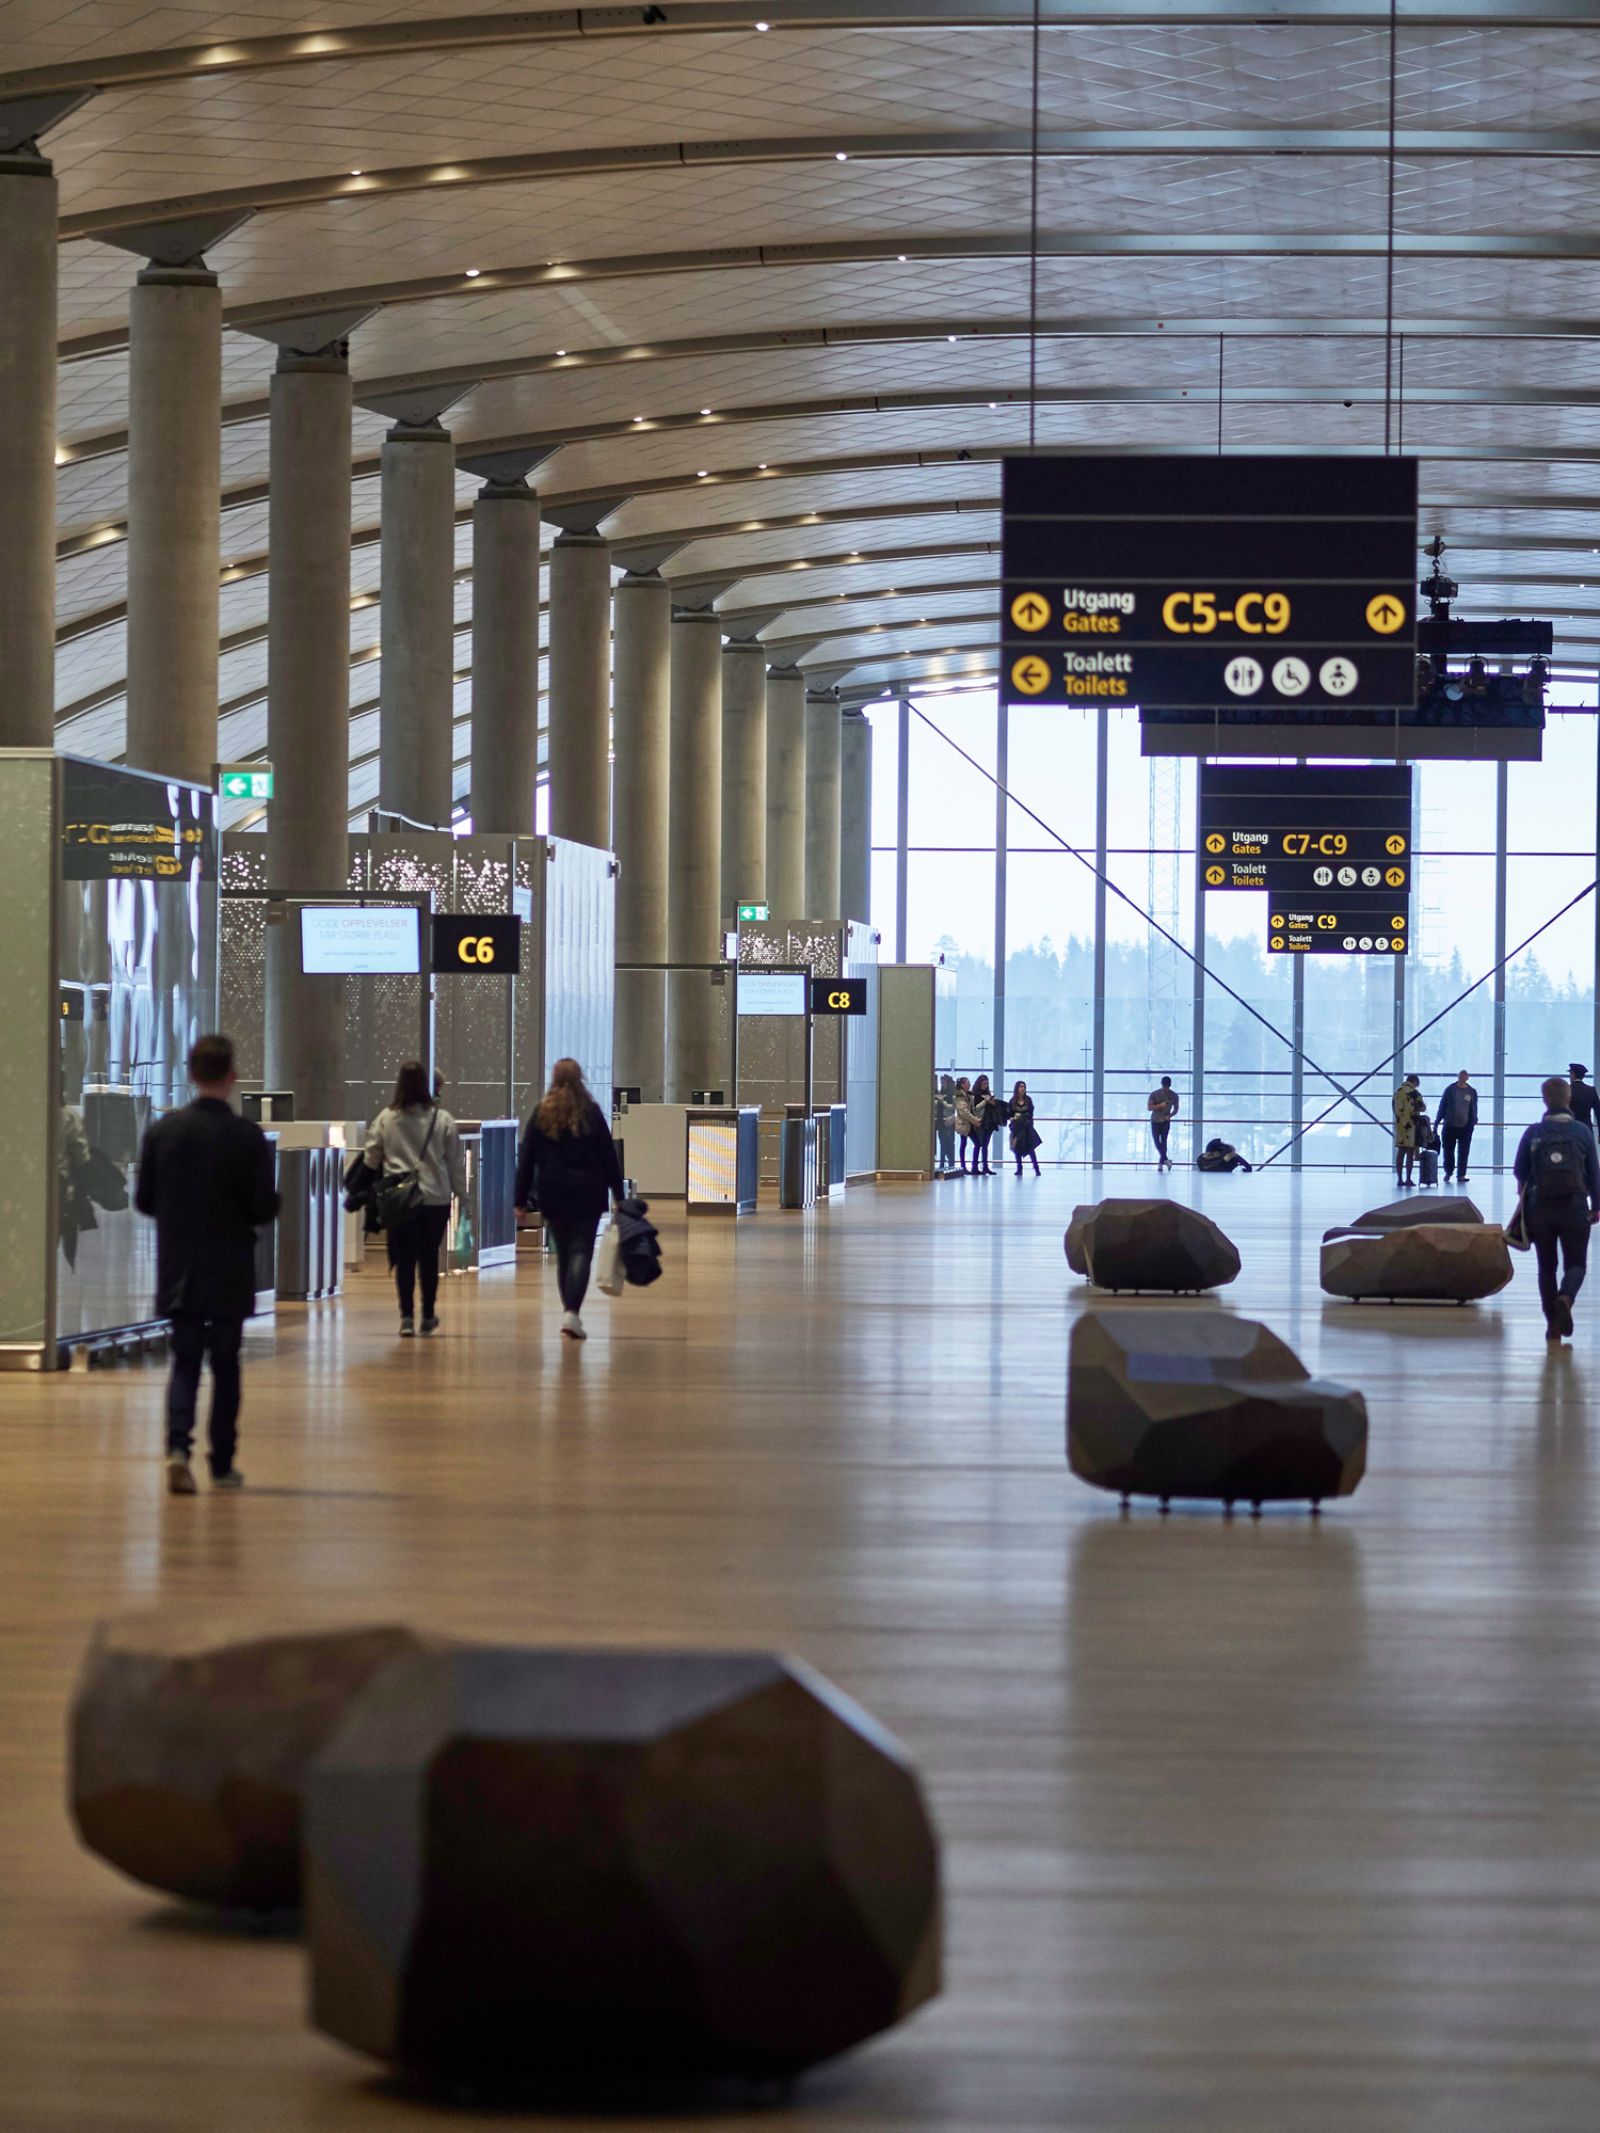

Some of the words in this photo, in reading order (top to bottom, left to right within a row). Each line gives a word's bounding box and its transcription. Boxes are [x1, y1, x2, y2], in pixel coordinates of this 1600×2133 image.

[1063, 588, 1135, 614] Utgang
[1162, 592, 1291, 634] C5-C9
[1063, 611, 1120, 633] Gates
[1063, 651, 1133, 673] Toalett
[1063, 674, 1127, 696] Toilets
[1232, 832, 1268, 844] Utgang
[1282, 834, 1348, 855] C7-C9
[1232, 844, 1261, 854] Gates
[1232, 863, 1267, 874] Toalett
[1232, 876, 1264, 886] Toilets
[1288, 914, 1313, 922] Utgang
[1317, 915, 1337, 929] C9
[1288, 935, 1312, 943] Toalett
[457, 936, 495, 964] C6
[827, 992, 850, 1009] C8
